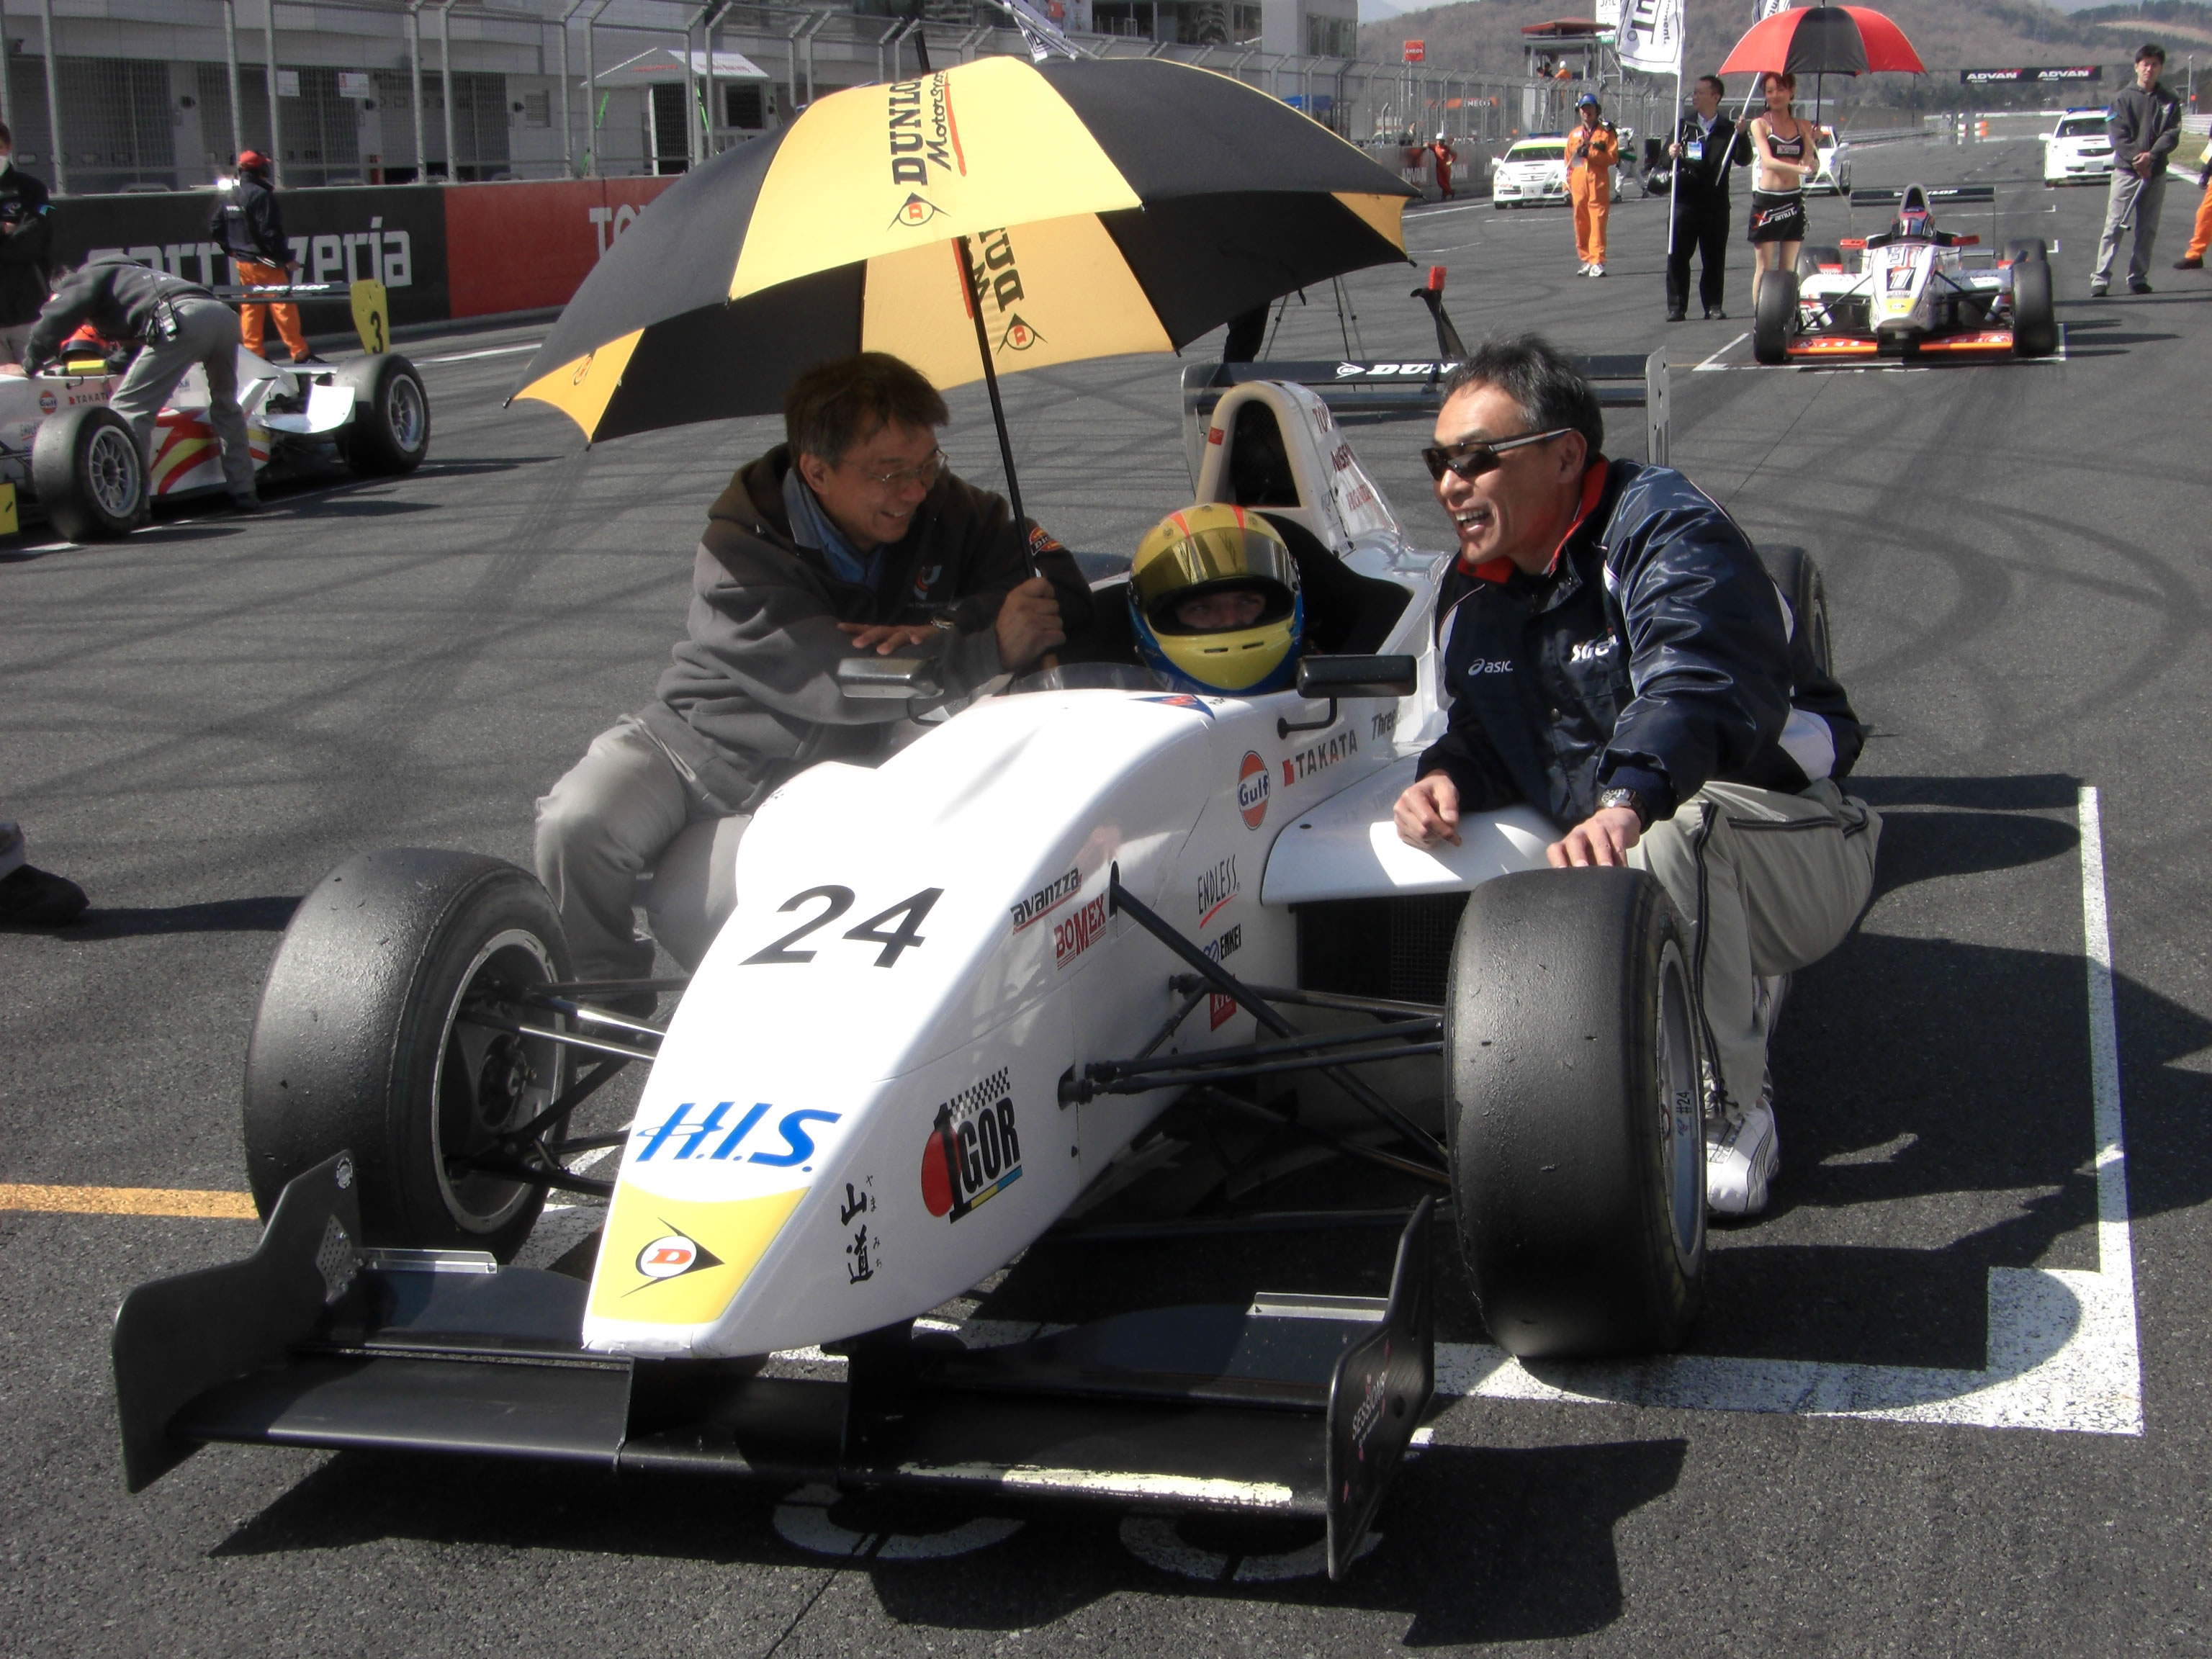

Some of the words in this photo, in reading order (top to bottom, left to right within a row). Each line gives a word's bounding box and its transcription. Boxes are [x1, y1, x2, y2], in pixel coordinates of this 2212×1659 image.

[370, 311, 383, 354] 3
[1296, 729, 1358, 778] TAKATA
[1238, 774, 1269, 807] Gulf
[1010, 868, 1079, 927] avanzza
[1197, 853, 1237, 915] ENDLESS
[737, 884, 945, 968] 24
[1054, 894, 1106, 958] BOMEX
[1220, 923, 1241, 961] ENKEI
[1676, 1090, 1691, 1114] #24
[841, 1183, 873, 1285] 山道
